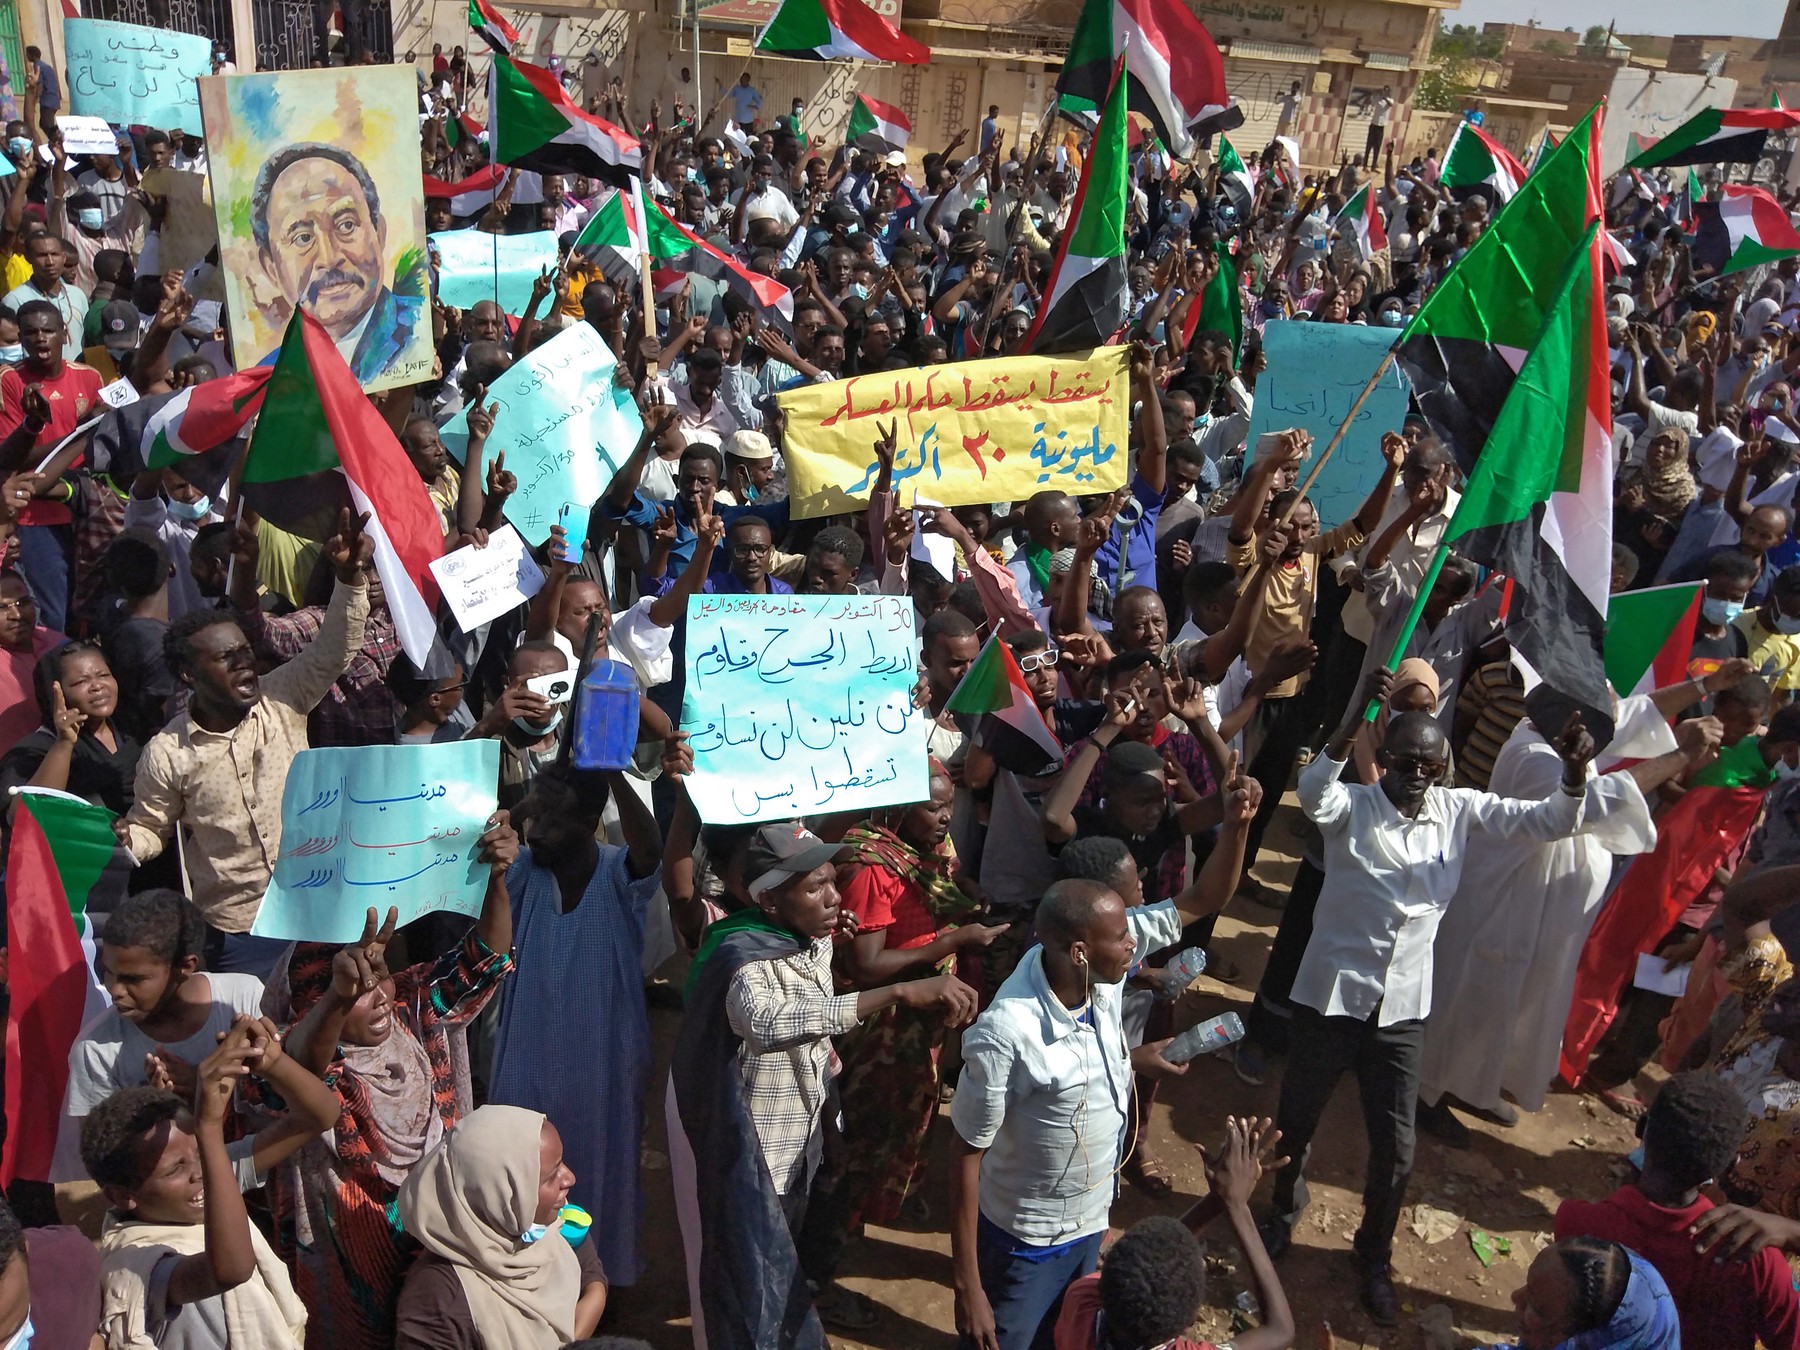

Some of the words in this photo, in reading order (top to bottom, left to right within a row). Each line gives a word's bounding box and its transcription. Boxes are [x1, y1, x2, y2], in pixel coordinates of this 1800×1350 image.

[820, 376, 912, 427] العسكر
[907, 370, 954, 444] حكم
[955, 374, 1036, 412] يسقط
[1040, 367, 1113, 405] يسقط
[962, 429, 1007, 481] ٣٠
[1029, 421, 1117, 484] مليونية
[888, 598, 912, 631] 30
[861, 629, 912, 680] اربط
[761, 698, 794, 761] لن
[797, 686, 865, 750] نلين
[732, 783, 798, 817] بس
[811, 746, 898, 806] تسقطوا
